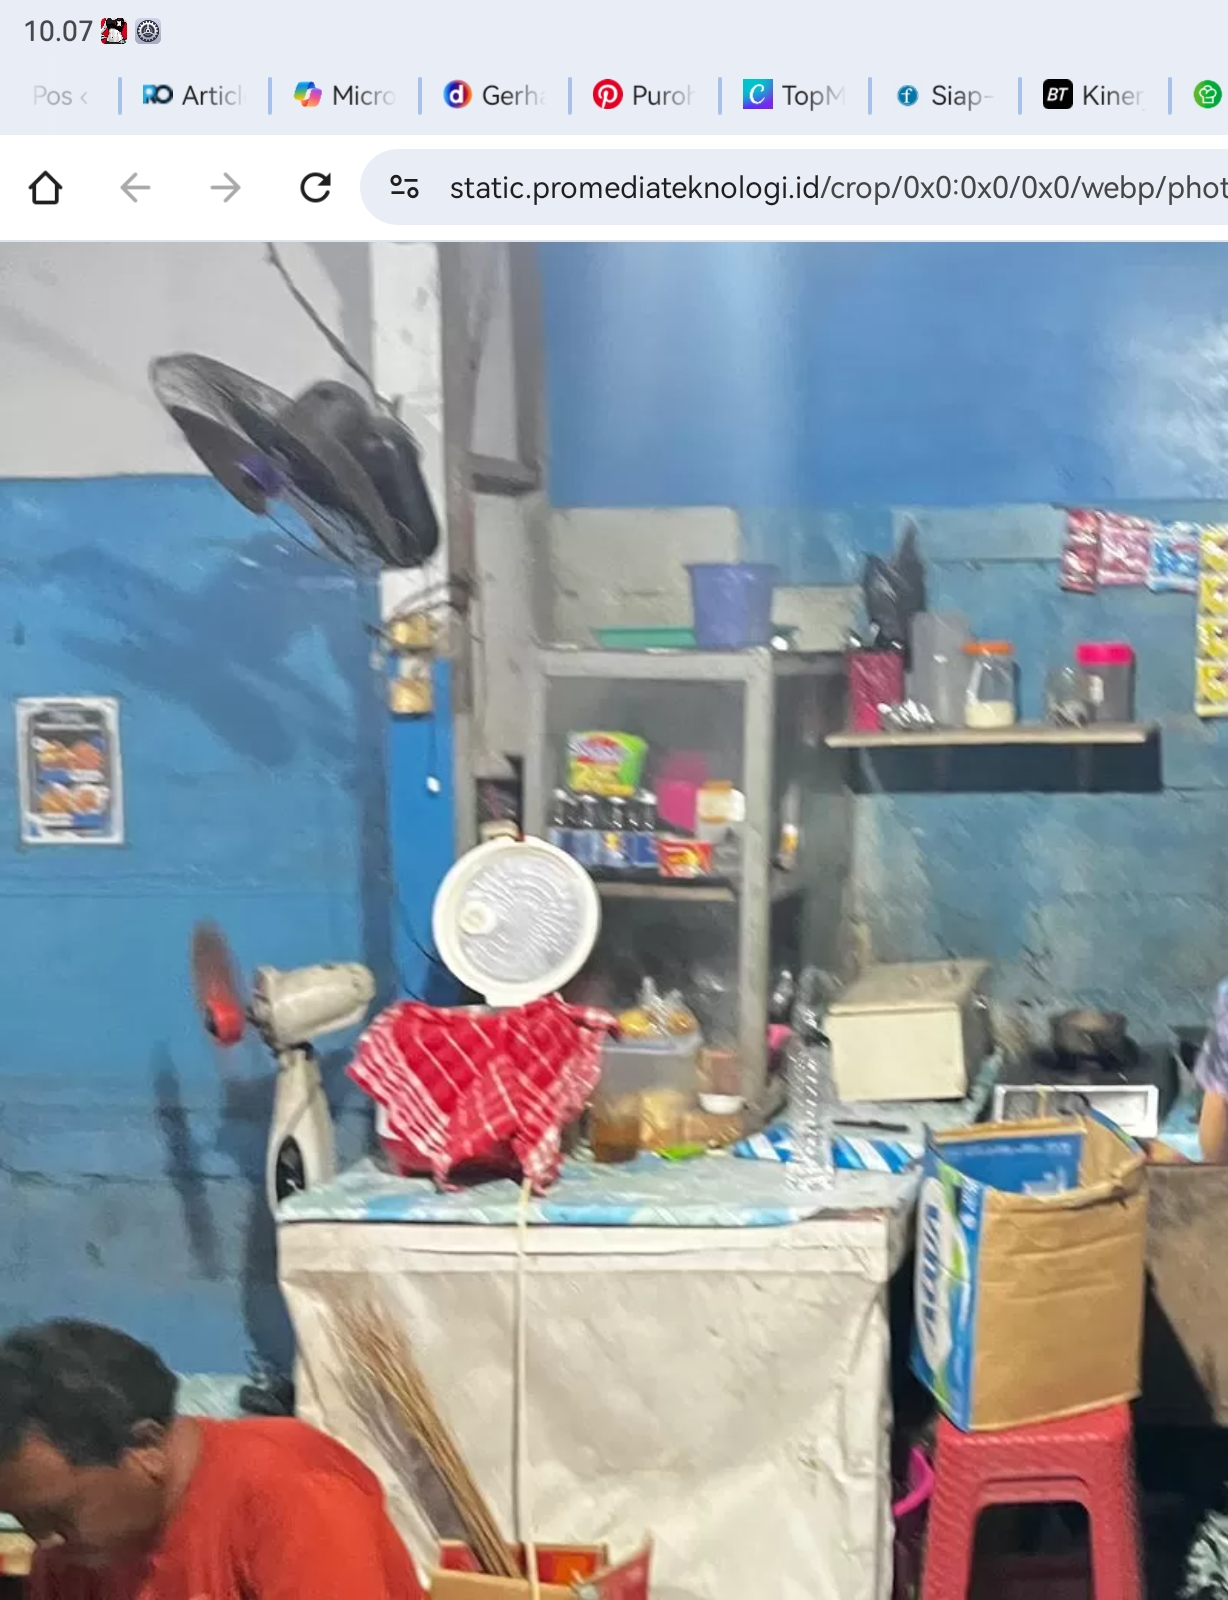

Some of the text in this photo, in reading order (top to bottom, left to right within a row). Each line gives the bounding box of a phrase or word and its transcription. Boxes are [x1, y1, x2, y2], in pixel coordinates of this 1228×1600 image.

[24, 19, 93, 43] 10.07
[33, 84, 73, 107] Pos
[182, 84, 246, 107] Articl
[333, 84, 396, 107] Micro
[782, 84, 846, 113] TopM
[932, 84, 995, 112] Siap-
[1083, 84, 1146, 112] Kiner
